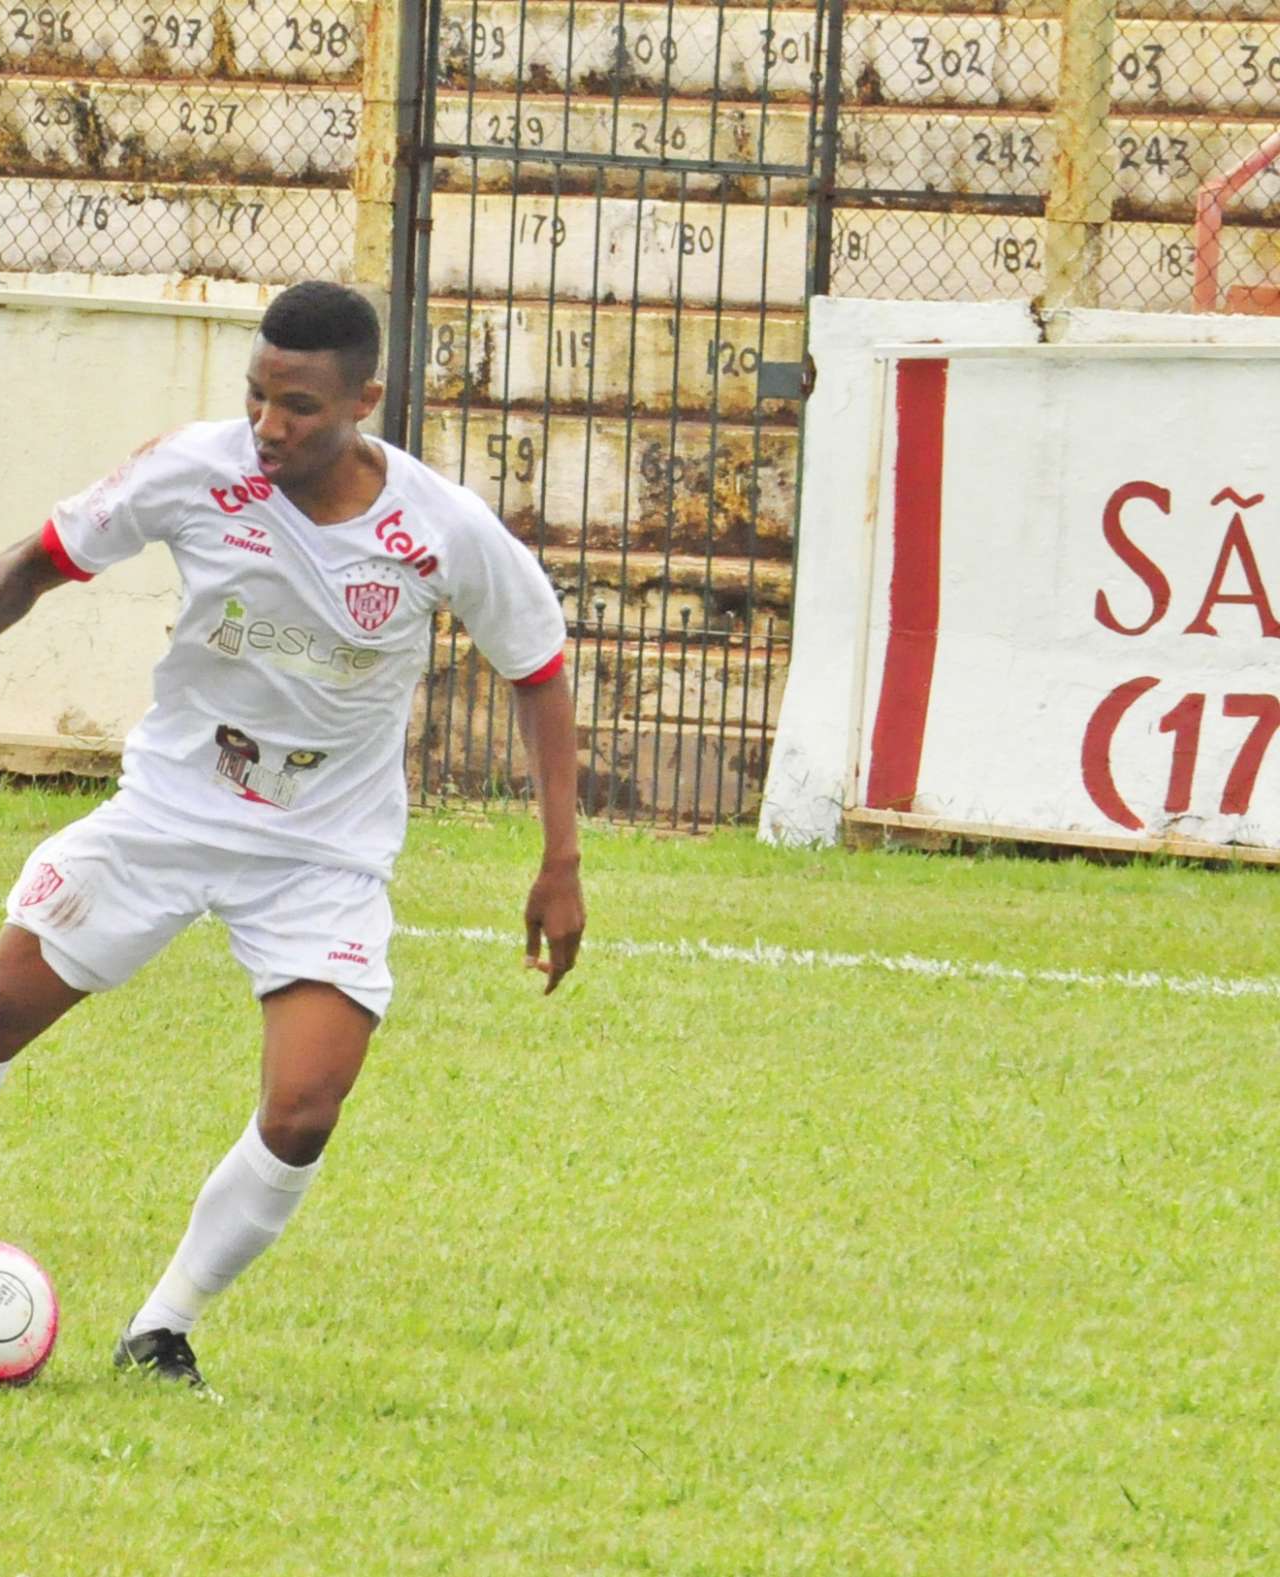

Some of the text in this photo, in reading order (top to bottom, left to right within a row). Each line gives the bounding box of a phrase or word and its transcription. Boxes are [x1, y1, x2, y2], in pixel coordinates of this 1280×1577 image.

[10, 8, 74, 44] 296
[143, 15, 203, 48] 297
[286, 18, 351, 57] 298
[912, 37, 987, 84] 302
[1119, 44, 1166, 90] 03
[34, 96, 86, 127] 23
[179, 101, 239, 135] 237
[324, 107, 358, 140] 23
[488, 116, 544, 147] 239
[632, 122, 687, 154] 240
[973, 132, 1041, 173] 242
[1119, 136, 1189, 178] 243
[66, 192, 110, 231] 176
[217, 202, 264, 235] 177
[520, 213, 566, 248] 179
[670, 221, 715, 255] 180
[993, 238, 1042, 274] 182
[707, 339, 758, 377] 120
[487, 433, 535, 483] 59
